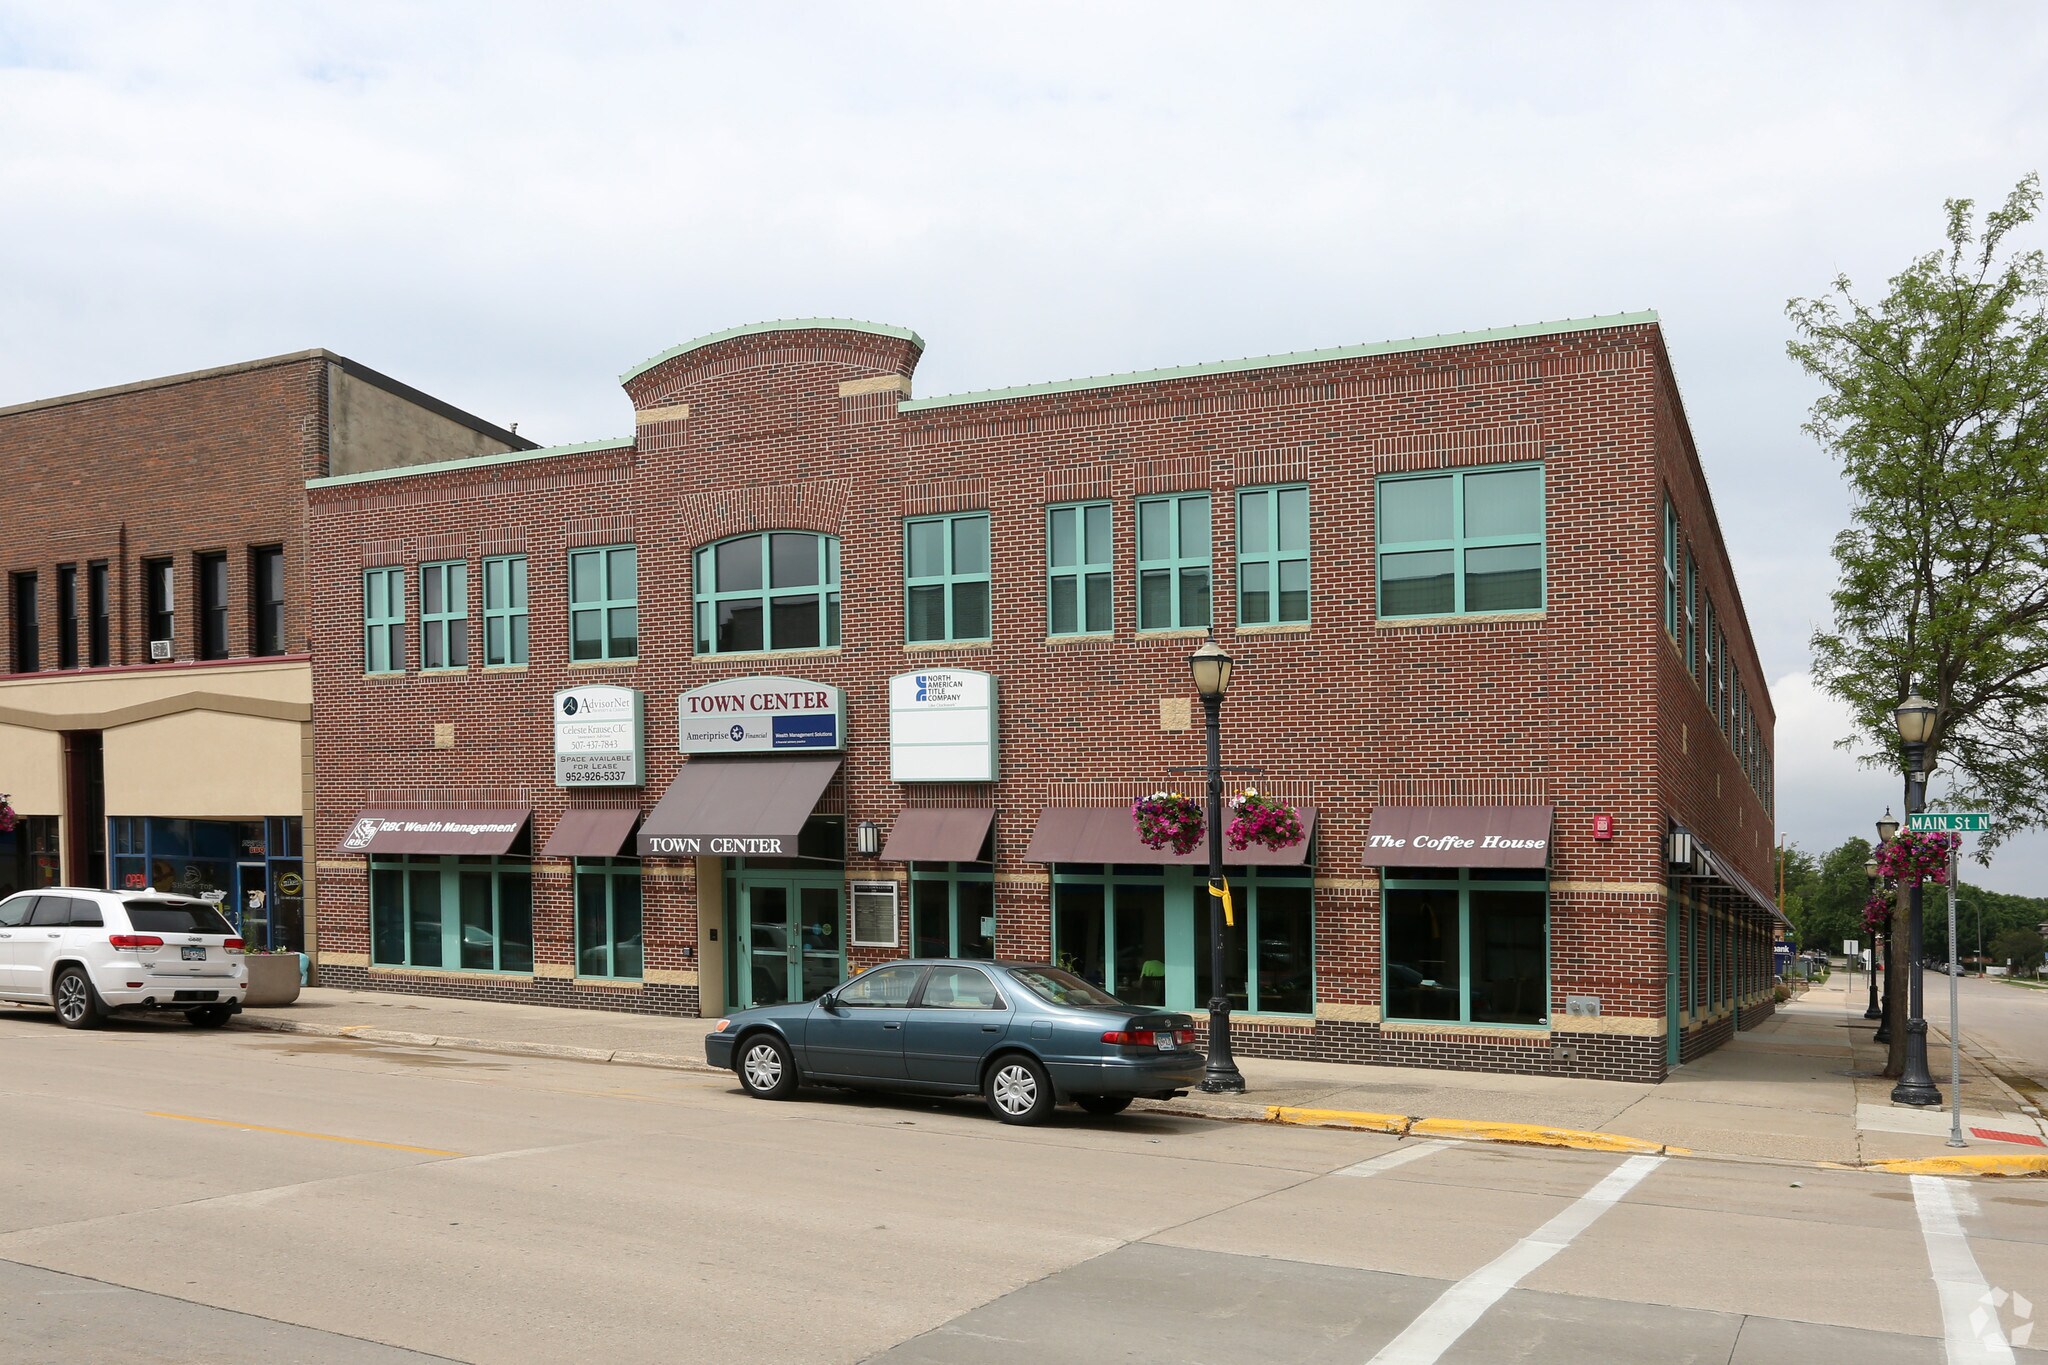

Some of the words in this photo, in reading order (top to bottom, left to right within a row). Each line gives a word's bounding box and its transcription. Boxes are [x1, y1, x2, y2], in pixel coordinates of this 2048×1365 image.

[579, 697, 630, 714] AdvisorNet
[688, 695, 745, 713] TOWN
[750, 691, 829, 711] CENTER
[562, 725, 587, 735] Celeste
[588, 725, 612, 734] Krause,
[613, 724, 627, 733] CIC
[686, 731, 729, 742] Ameriprise
[571, 740, 618, 750] 507-437-7843
[565, 771, 626, 782] 952-926-5337
[379, 821, 404, 832] RBC
[404, 821, 442, 832] Wealth
[442, 822, 518, 835] Management
[1911, 816, 1947, 830] MAIN
[1954, 816, 1970, 830] St
[1978, 816, 1988, 829] N
[347, 838, 369, 847] RBC
[650, 837, 701, 853] TOWN
[710, 838, 783, 854] CENTER
[1369, 835, 1406, 848] The
[1412, 835, 1475, 851] Coffee
[1480, 835, 1546, 849] House
[125, 873, 147, 889] OPEN
